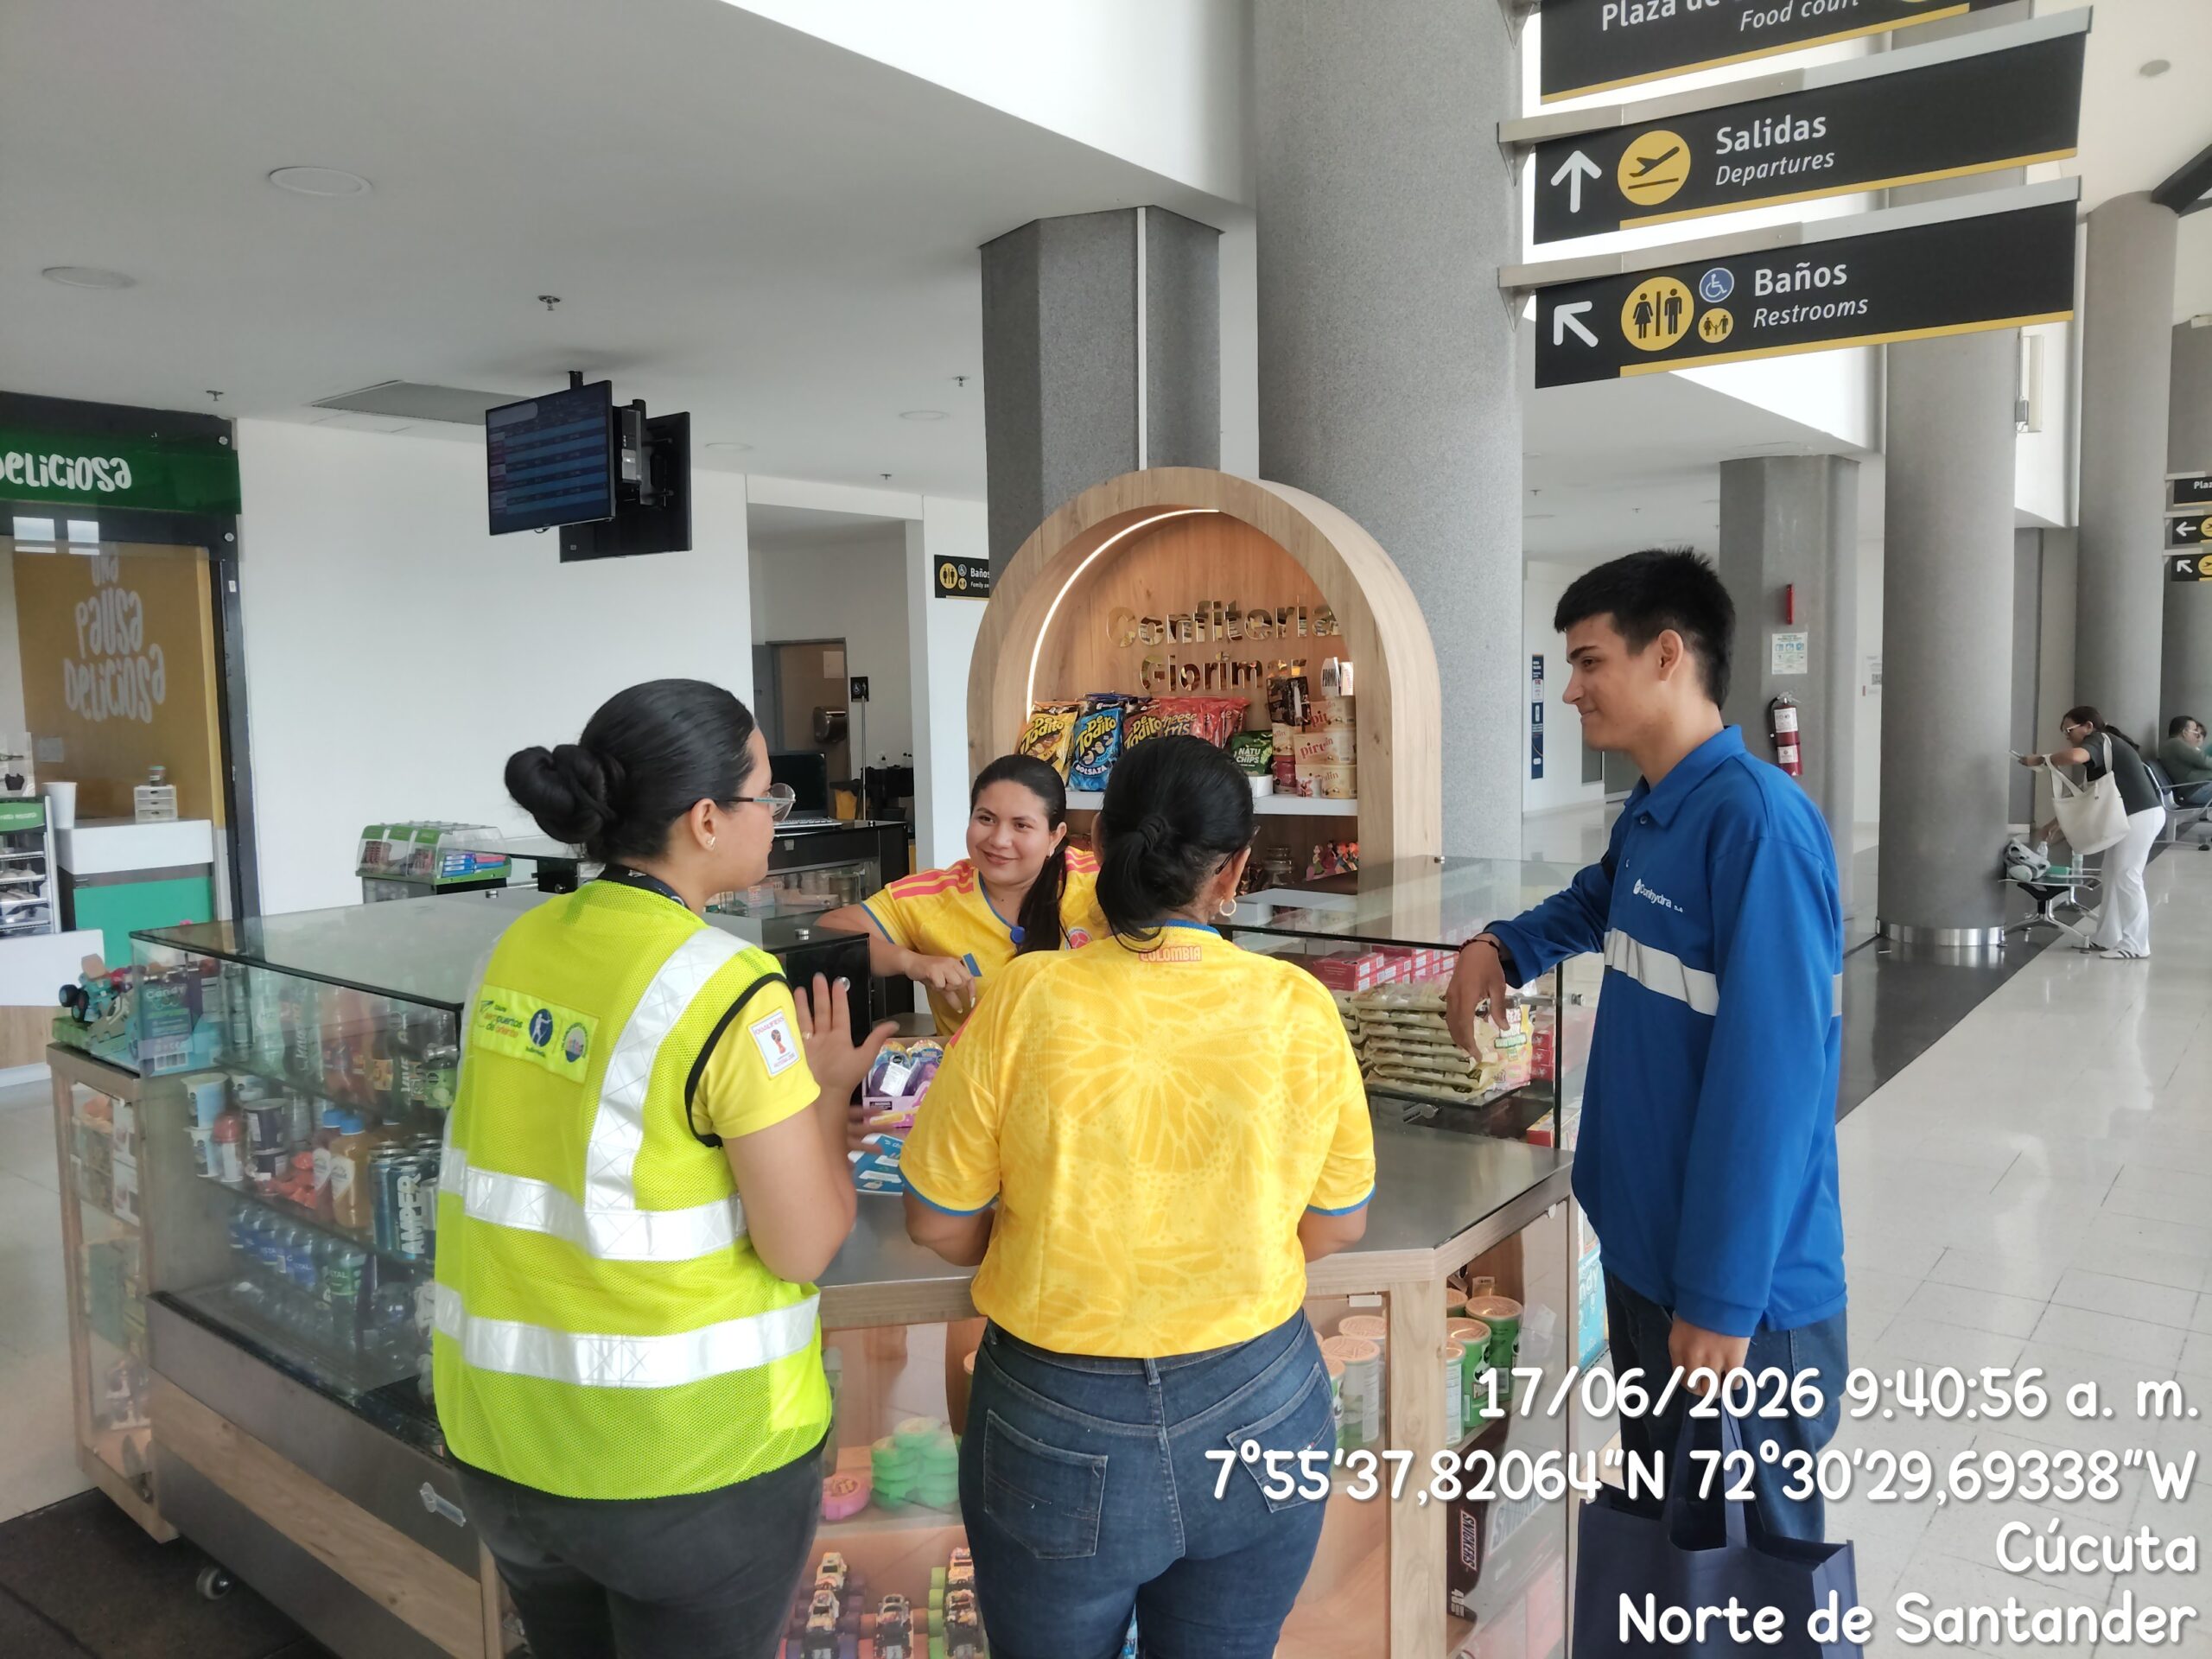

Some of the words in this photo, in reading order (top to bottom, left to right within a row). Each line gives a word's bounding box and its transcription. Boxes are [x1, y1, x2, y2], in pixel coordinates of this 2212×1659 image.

[1602, 0, 1676, 31] Plaza
[1740, 0, 1794, 31] Food
[1715, 114, 1827, 155] Salidas
[1715, 152, 1835, 186] Departures
[1755, 262, 1847, 296] Baños
[1752, 298, 1868, 328] Restrooms
[0, 451, 132, 493] eliciosa
[1140, 946, 1202, 962] COLOMBIA
[1462, 1513, 1476, 1568] SNICKERS
